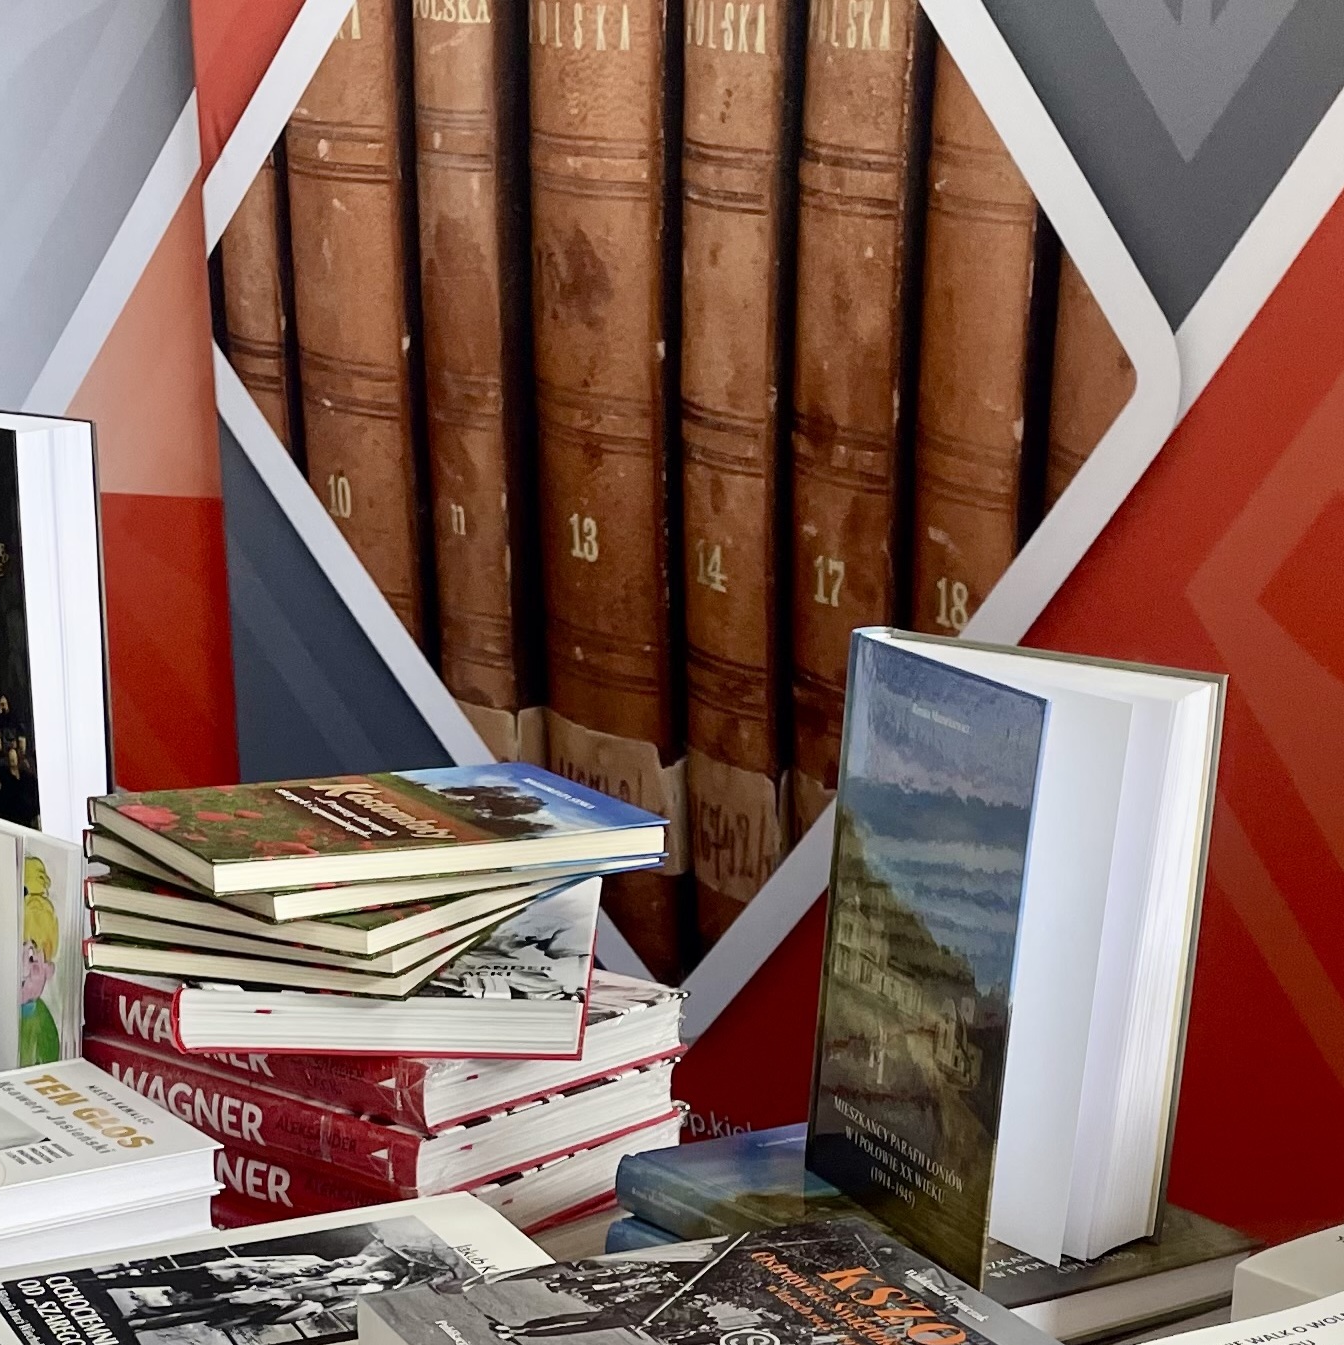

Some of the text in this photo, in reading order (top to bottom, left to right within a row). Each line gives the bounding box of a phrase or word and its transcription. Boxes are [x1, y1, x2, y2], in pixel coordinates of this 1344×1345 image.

[327, 474, 352, 519] 10
[568, 513, 600, 563] 13
[696, 538, 729, 593] 14
[813, 555, 845, 607] 17
[936, 577, 968, 631] 18
[23, 1074, 155, 1149] TEN GŁOS
[834, 1095, 965, 1194] MIESZKAŃCY PARAFII ŁONIÓW
[845, 1125, 855, 1141] W
[858, 1136, 899, 1173] POŁOWIE
[899, 1161, 914, 1183] XX
[914, 1174, 946, 1204] WIEKU
[16, 1279, 46, 1297] OD
[1293, 1325, 1308, 1336] O
